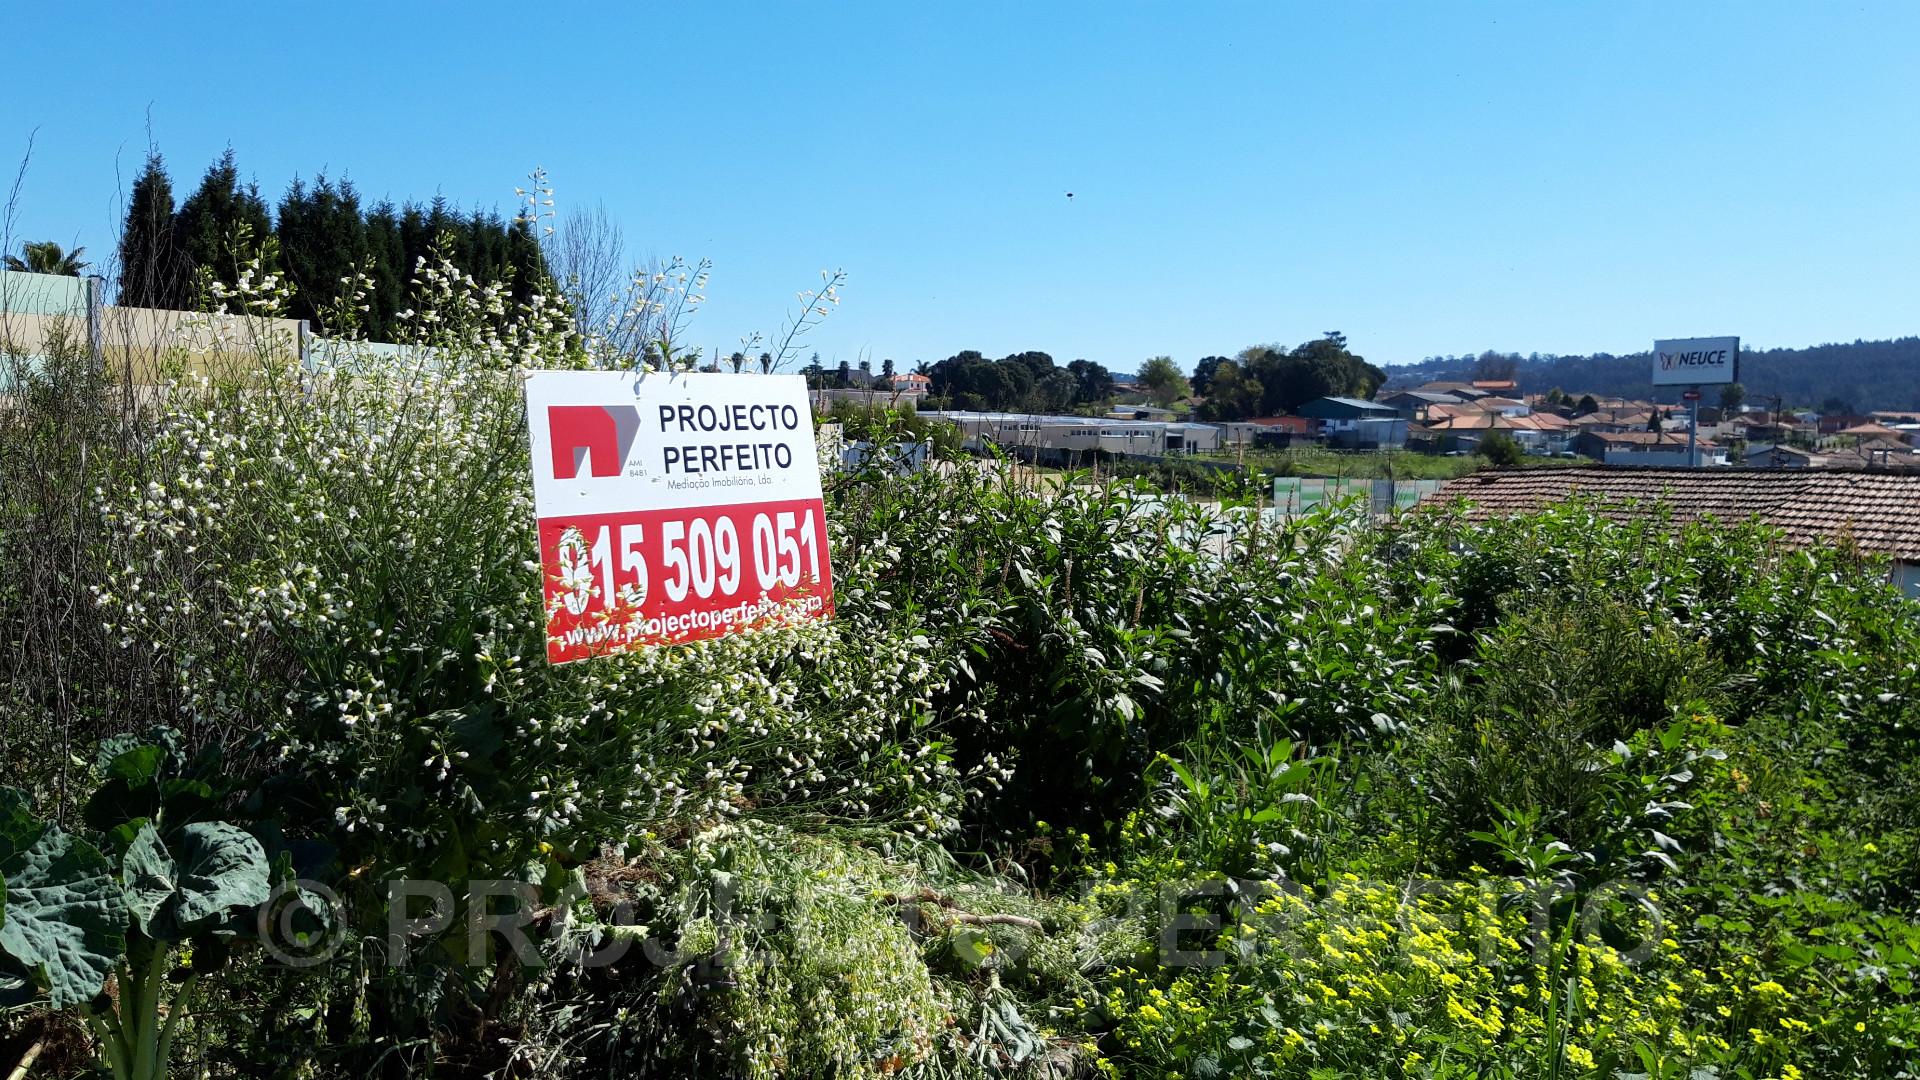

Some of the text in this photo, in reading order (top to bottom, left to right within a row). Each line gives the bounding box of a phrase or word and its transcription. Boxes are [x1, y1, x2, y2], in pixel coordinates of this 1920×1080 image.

[1679, 350, 1727, 366] NEUCE
[659, 404, 798, 432] PROJECTO
[629, 459, 643, 467] AMI
[664, 443, 792, 474] PERFEITO
[667, 479, 710, 491] Mediação
[662, 516, 741, 602] 509
[753, 509, 821, 592] 051
